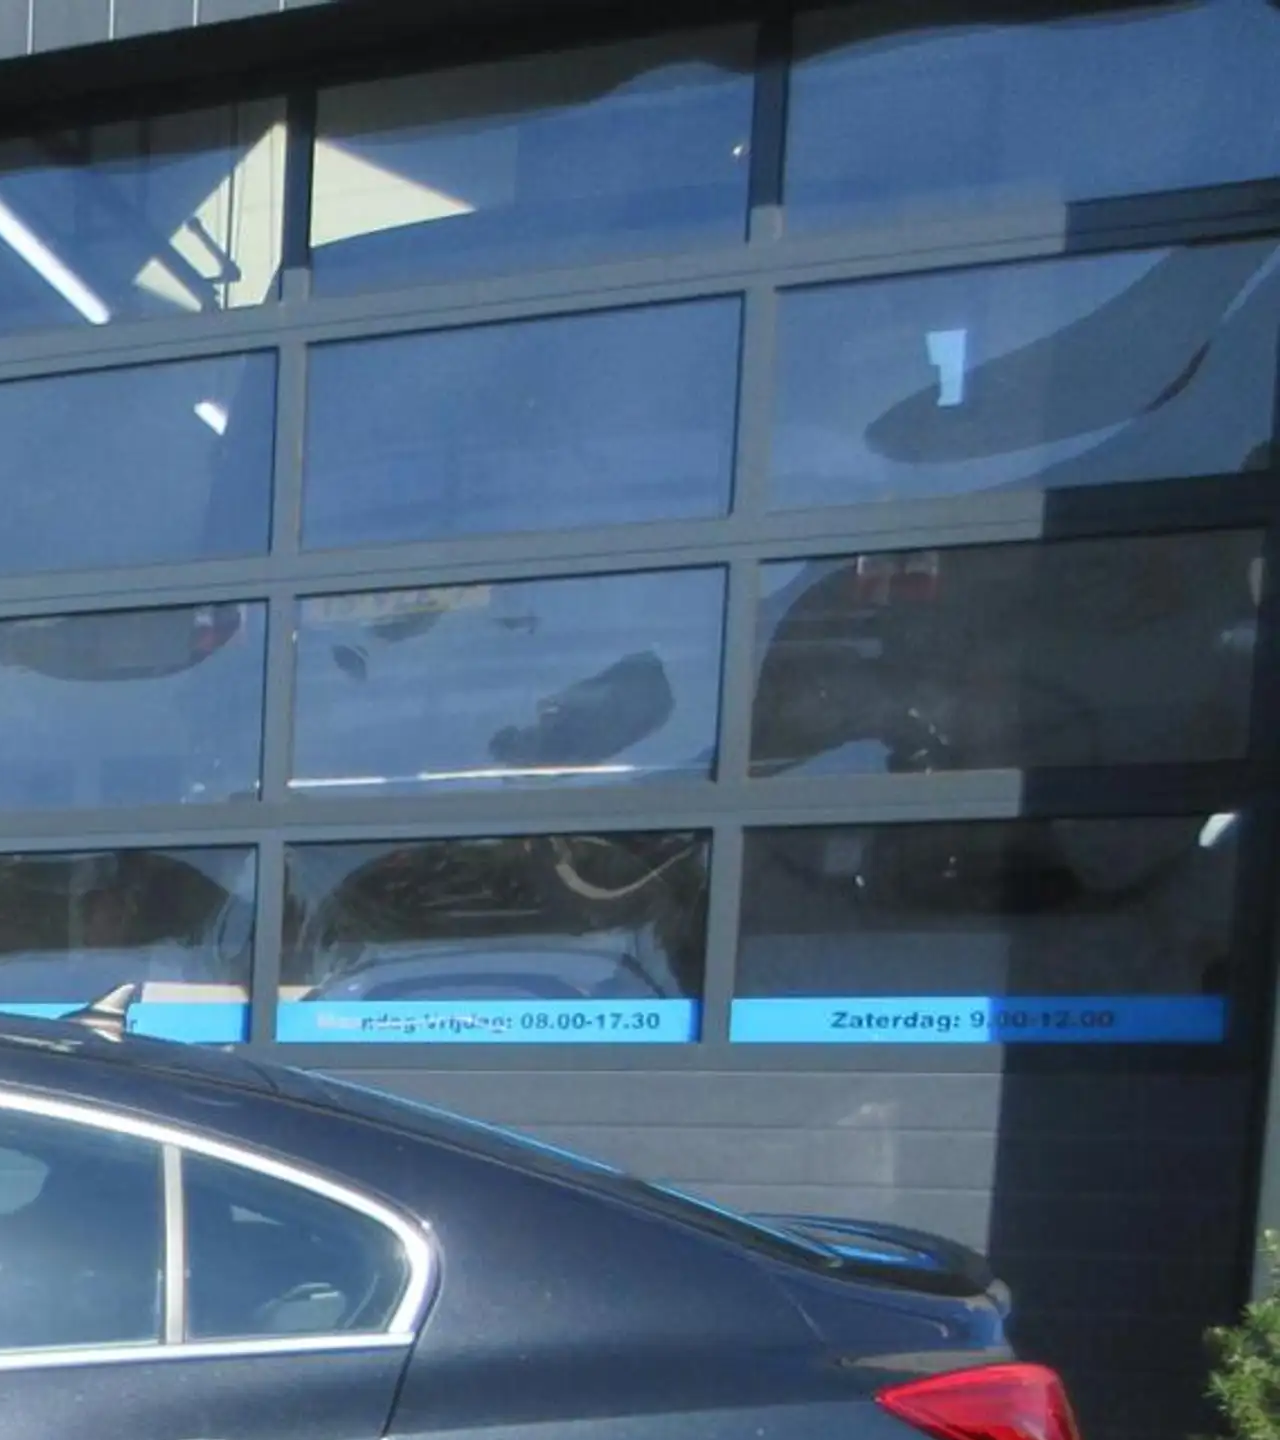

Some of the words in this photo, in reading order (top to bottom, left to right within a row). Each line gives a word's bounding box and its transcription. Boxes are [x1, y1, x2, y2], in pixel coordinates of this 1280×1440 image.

[519, 1012, 662, 1031] 08.00-17.30
[830, 1010, 961, 1033] Zaterdag:
[969, 1010, 1116, 1030] 9.00-12.00
